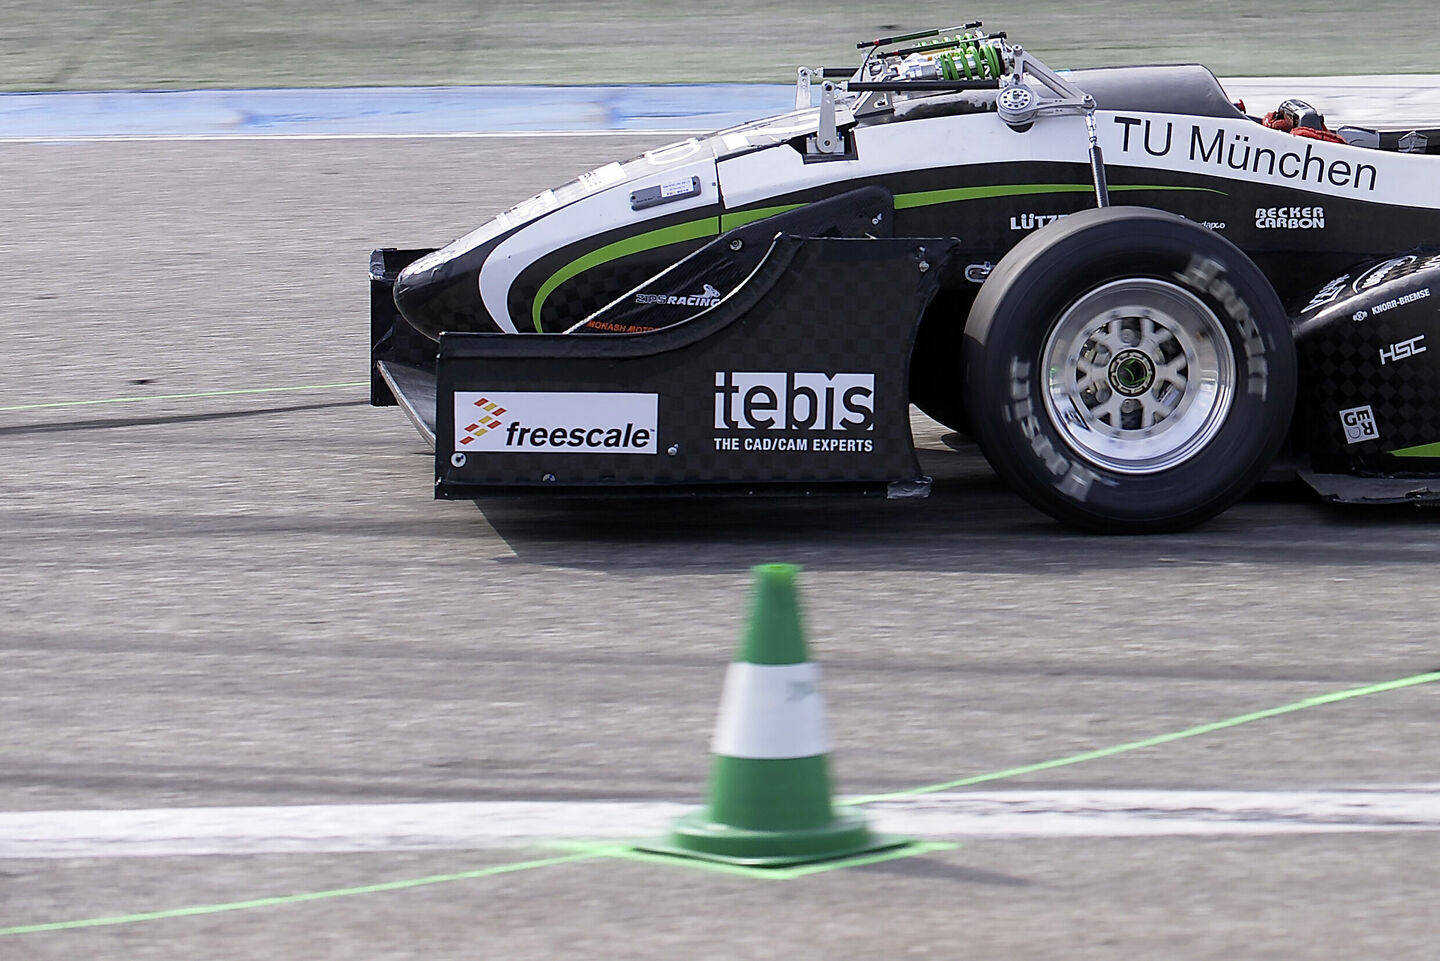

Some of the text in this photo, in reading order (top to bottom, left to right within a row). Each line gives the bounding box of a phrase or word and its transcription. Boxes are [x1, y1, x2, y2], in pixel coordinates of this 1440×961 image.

[1114, 116, 1378, 192] TU München
[1010, 213, 1068, 230] LÜTZ
[1255, 207, 1324, 219] BECKER
[1255, 218, 1325, 229] CARBON
[1371, 288, 1431, 316] KNORR-BREMSE
[586, 320, 627, 332] MONASH
[1379, 334, 1427, 365] HSC
[714, 372, 875, 431] tebis
[505, 422, 650, 448] freescale
[713, 438, 873, 452] THE CAD/CAM EXPERTS
